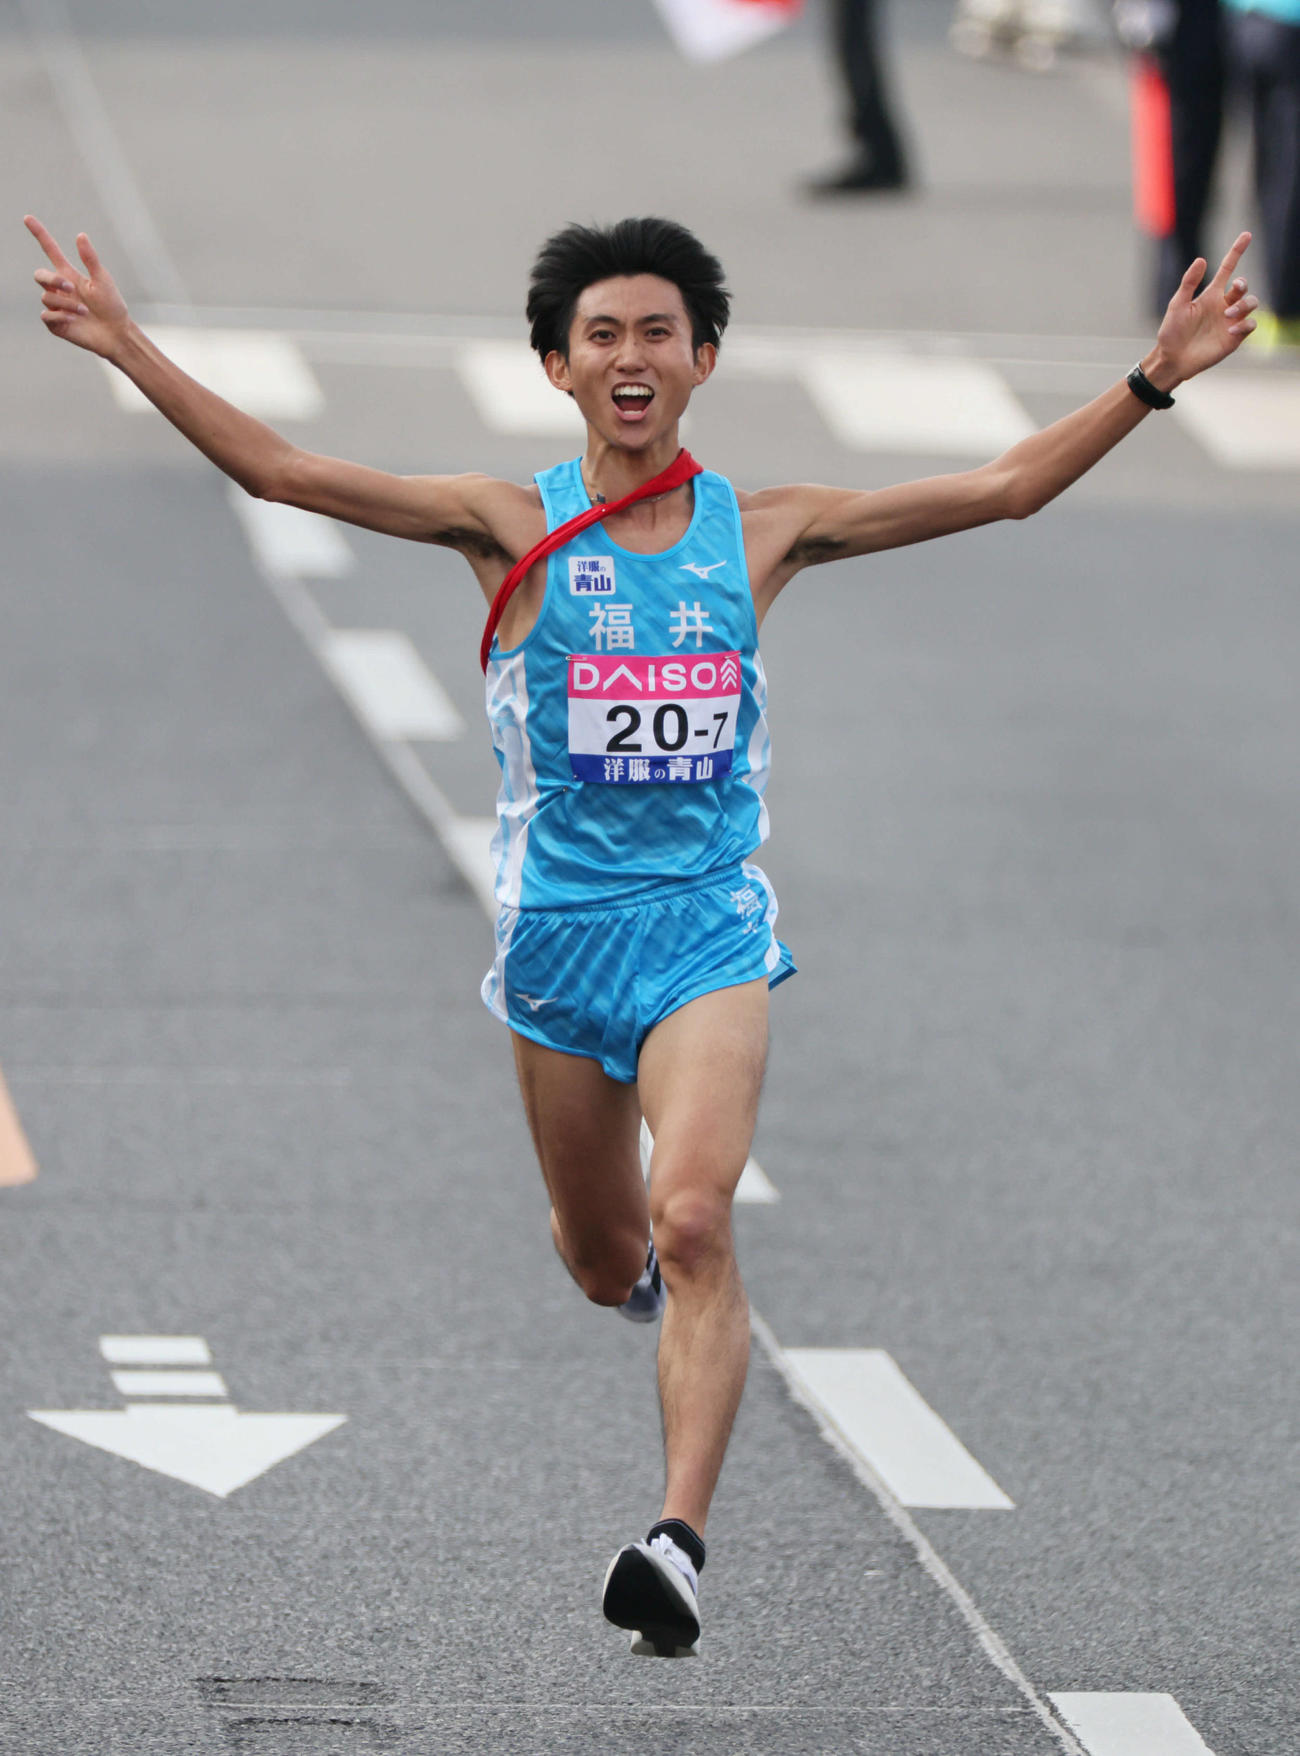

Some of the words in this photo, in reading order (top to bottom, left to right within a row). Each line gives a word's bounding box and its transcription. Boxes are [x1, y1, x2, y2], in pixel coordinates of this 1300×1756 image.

[577, 560, 607, 572] 洋服の
[574, 574, 612, 592] 青山
[573, 663, 717, 692] DAISO
[605, 704, 729, 753] 20-7
[603, 757, 713, 782] 洋服の青山
